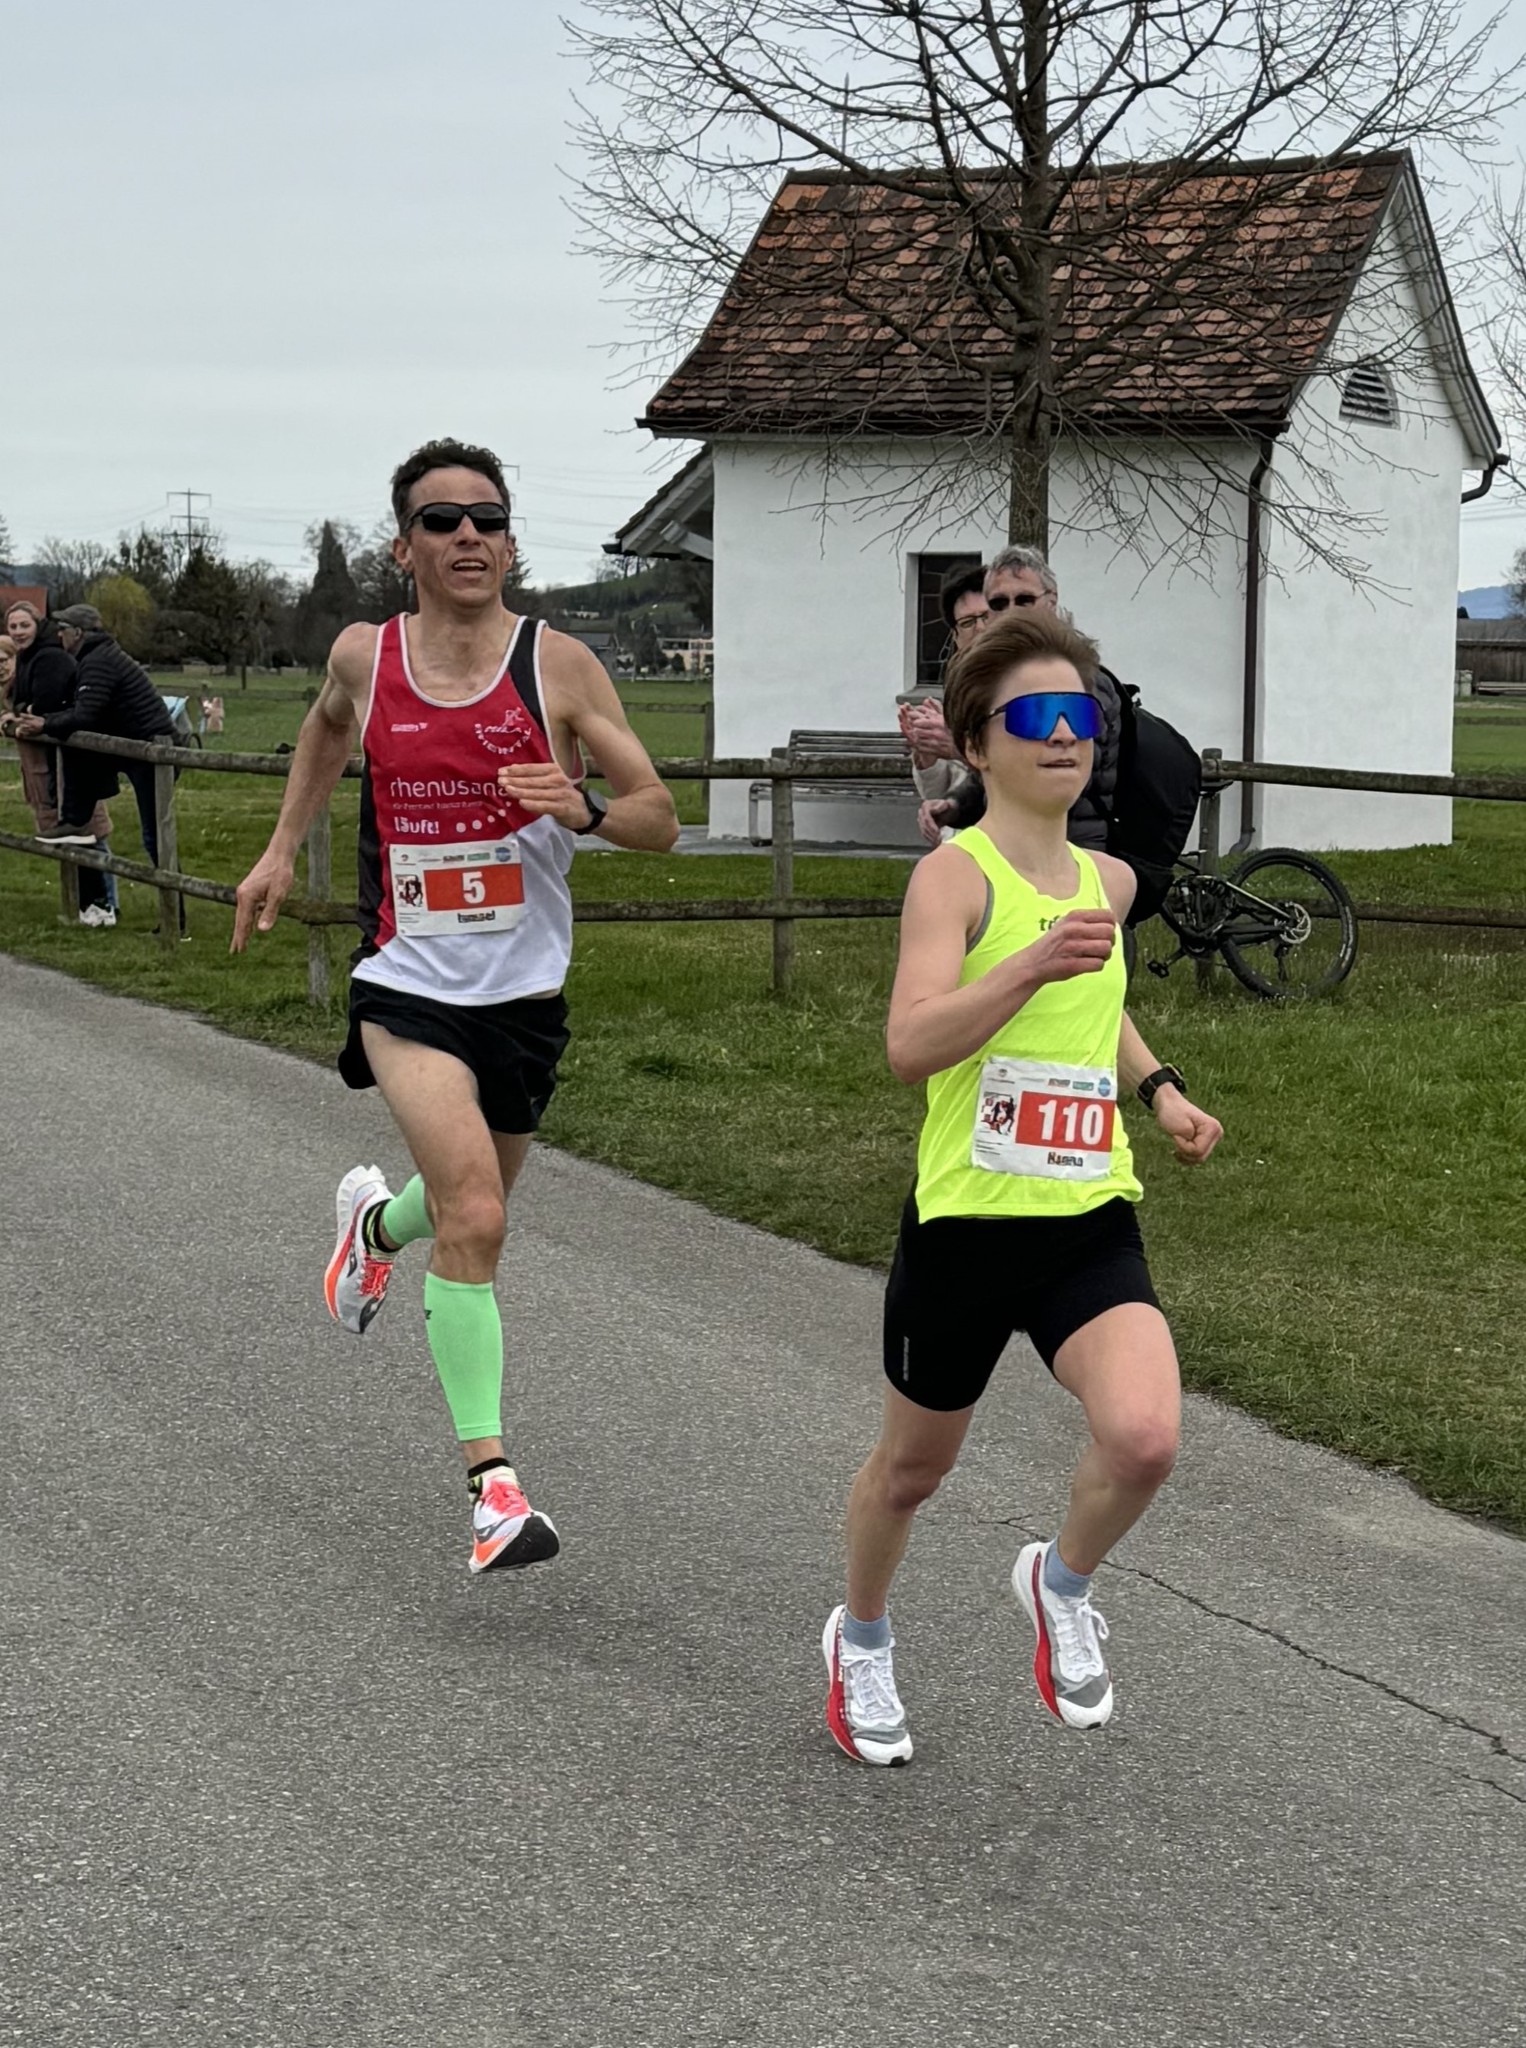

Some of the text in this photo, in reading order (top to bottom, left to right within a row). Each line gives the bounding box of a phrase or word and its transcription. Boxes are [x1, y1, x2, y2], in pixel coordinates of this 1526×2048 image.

[393, 816, 440, 835] läuft!
[462, 871, 486, 904] 5
[1038, 1099, 1105, 1146] 110
